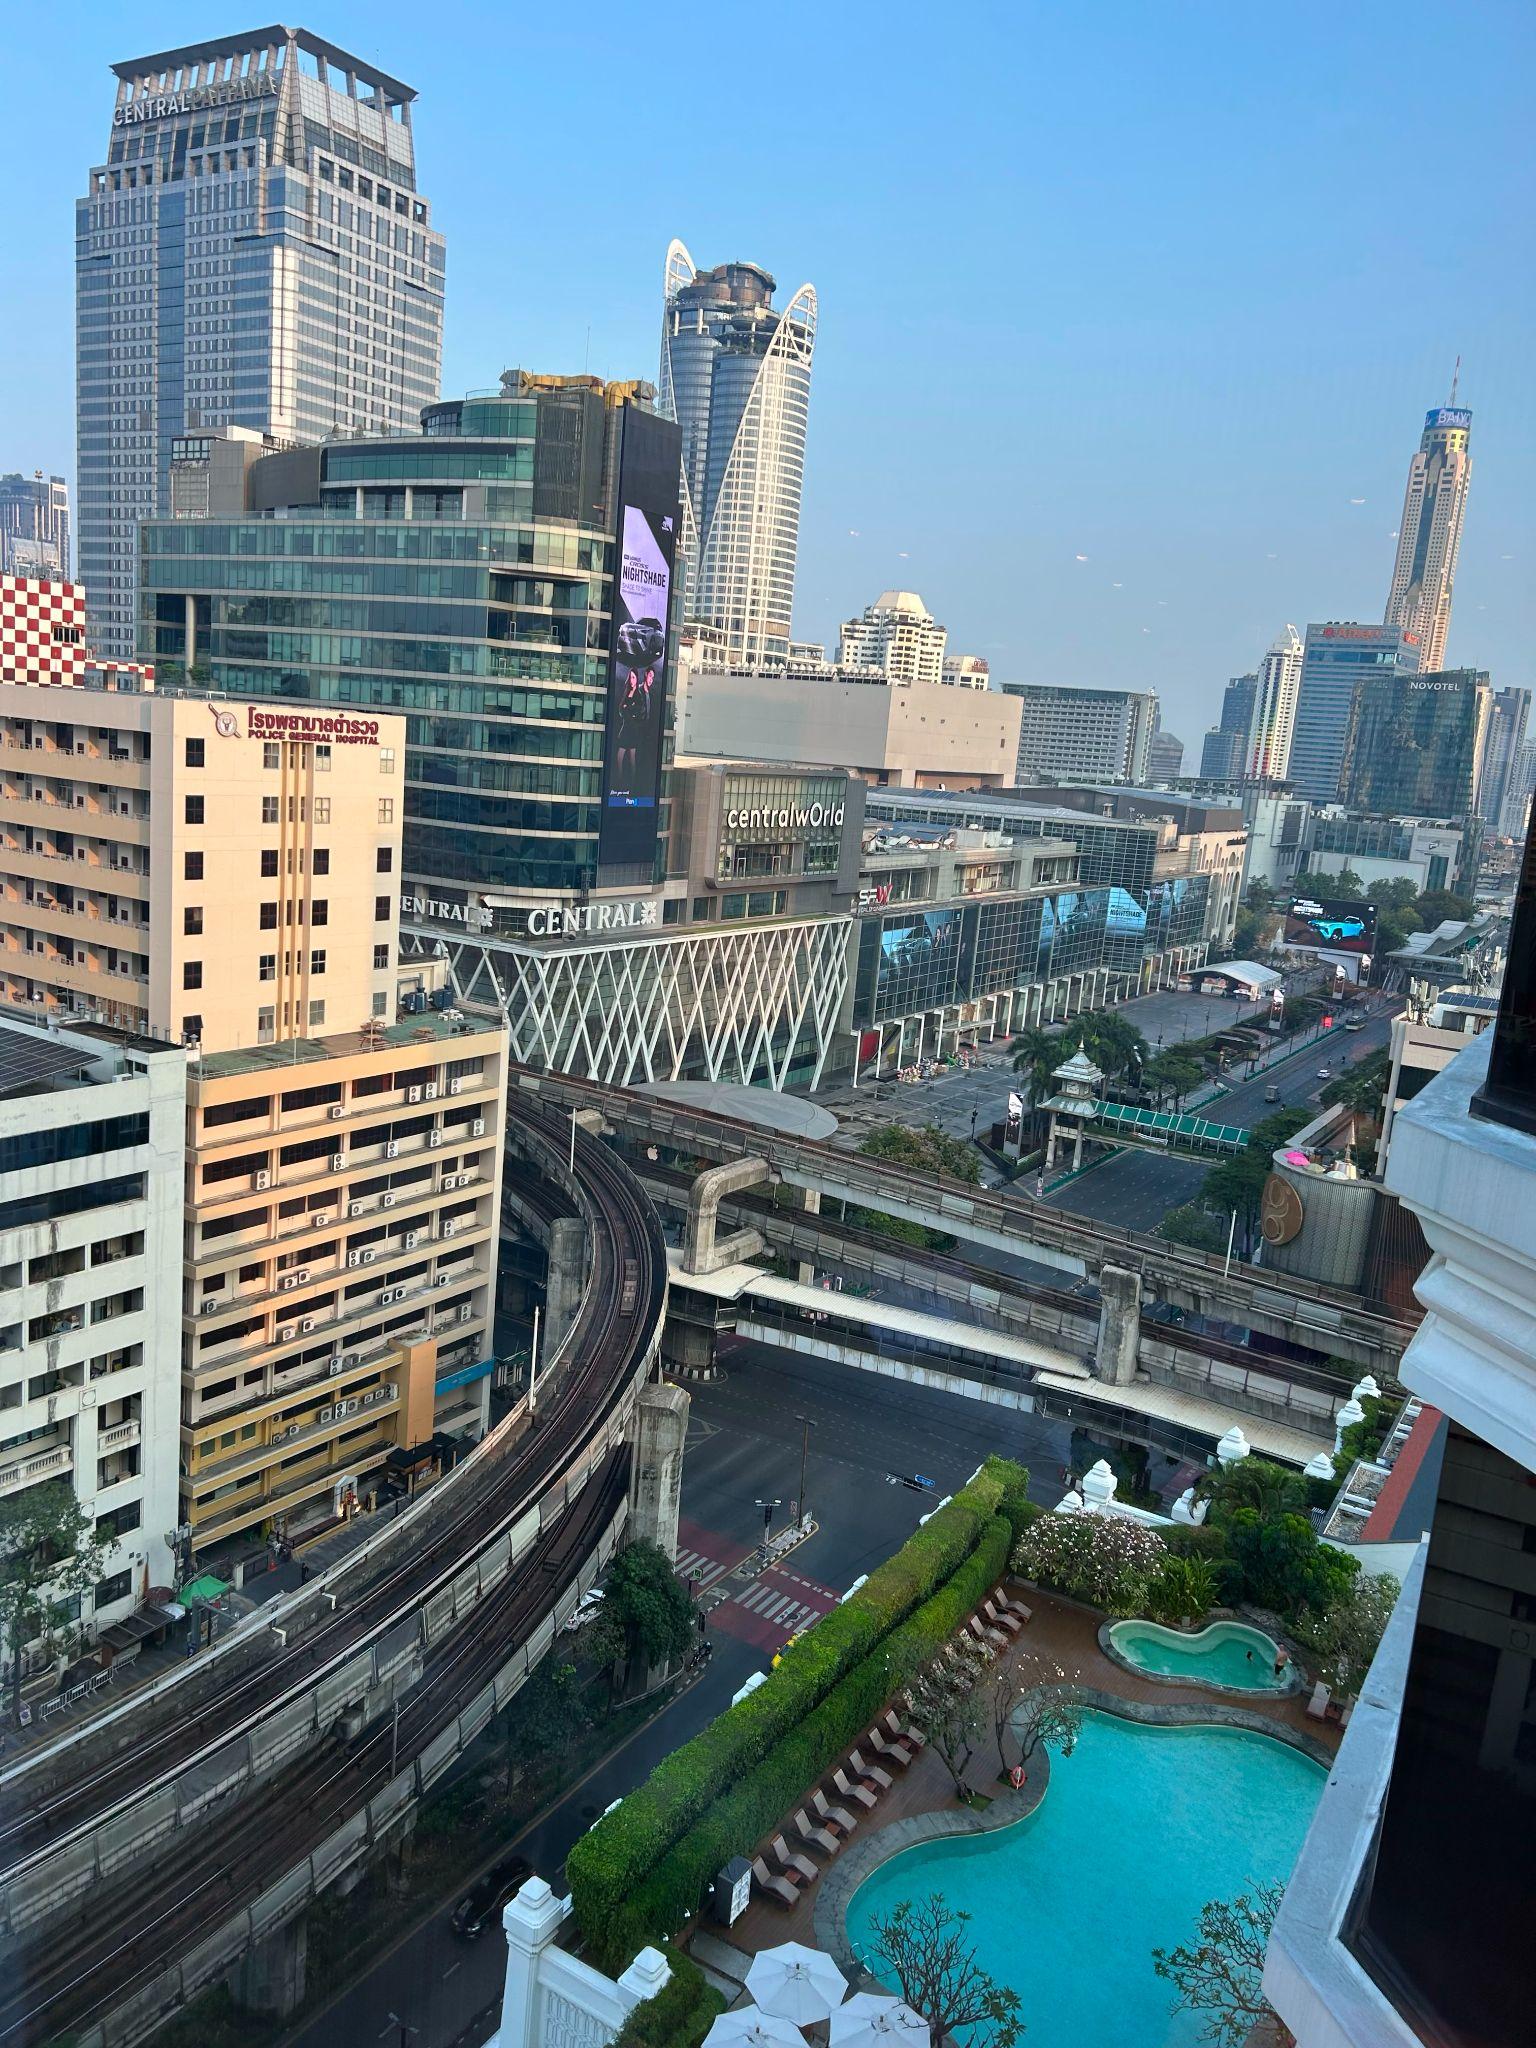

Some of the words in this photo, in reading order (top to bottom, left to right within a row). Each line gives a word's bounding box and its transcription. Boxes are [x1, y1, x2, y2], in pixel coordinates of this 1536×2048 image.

[622, 565, 667, 588] NIGHTSHADE
[1410, 681, 1460, 691] NOVOTEL
[248, 706, 379, 735] โรงพยาบาลตำรวจ
[248, 729, 285, 740] POLICE
[289, 732, 332, 743] GENERAL
[336, 735, 379, 745] HOSPITAL
[400, 895, 476, 924] ENTRAL
[527, 902, 642, 936] CENTRAL
